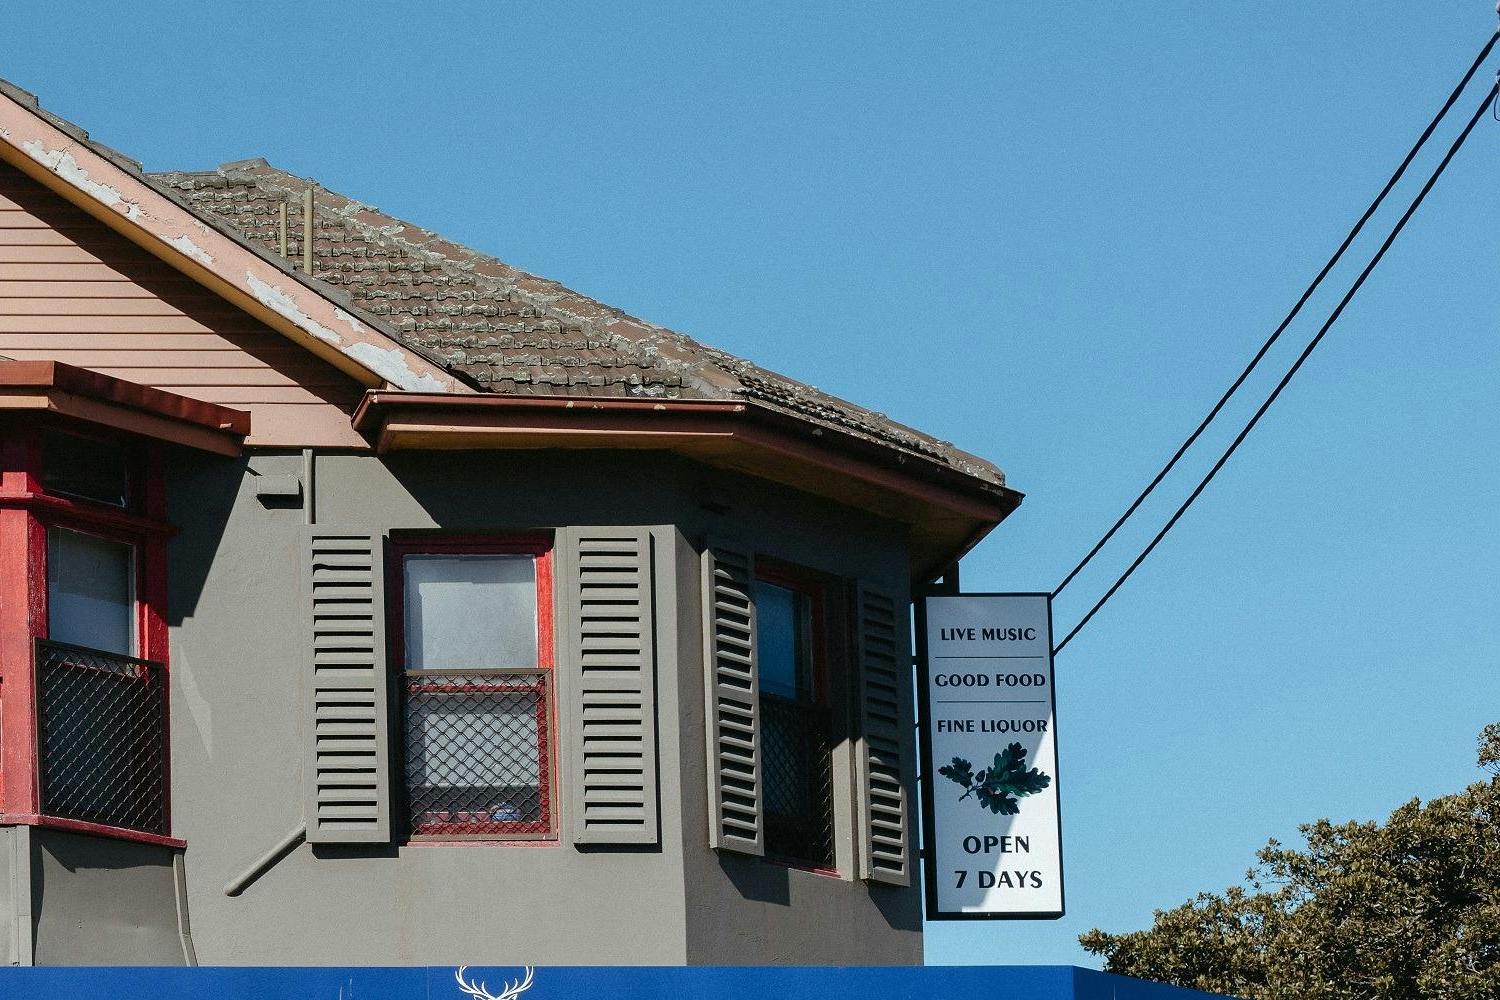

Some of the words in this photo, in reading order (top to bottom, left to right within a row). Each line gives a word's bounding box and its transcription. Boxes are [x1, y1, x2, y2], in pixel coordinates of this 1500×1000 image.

[940, 627, 976, 642] LIVE
[981, 627, 1037, 642] MUSIC
[934, 673, 990, 687] GOOD
[995, 673, 1046, 687] FOOD
[937, 719, 975, 733] FINE
[981, 719, 1048, 733] LIQUOR
[962, 835, 1030, 854] OPEN
[954, 870, 968, 889] 7
[978, 870, 1043, 889] DAYS
